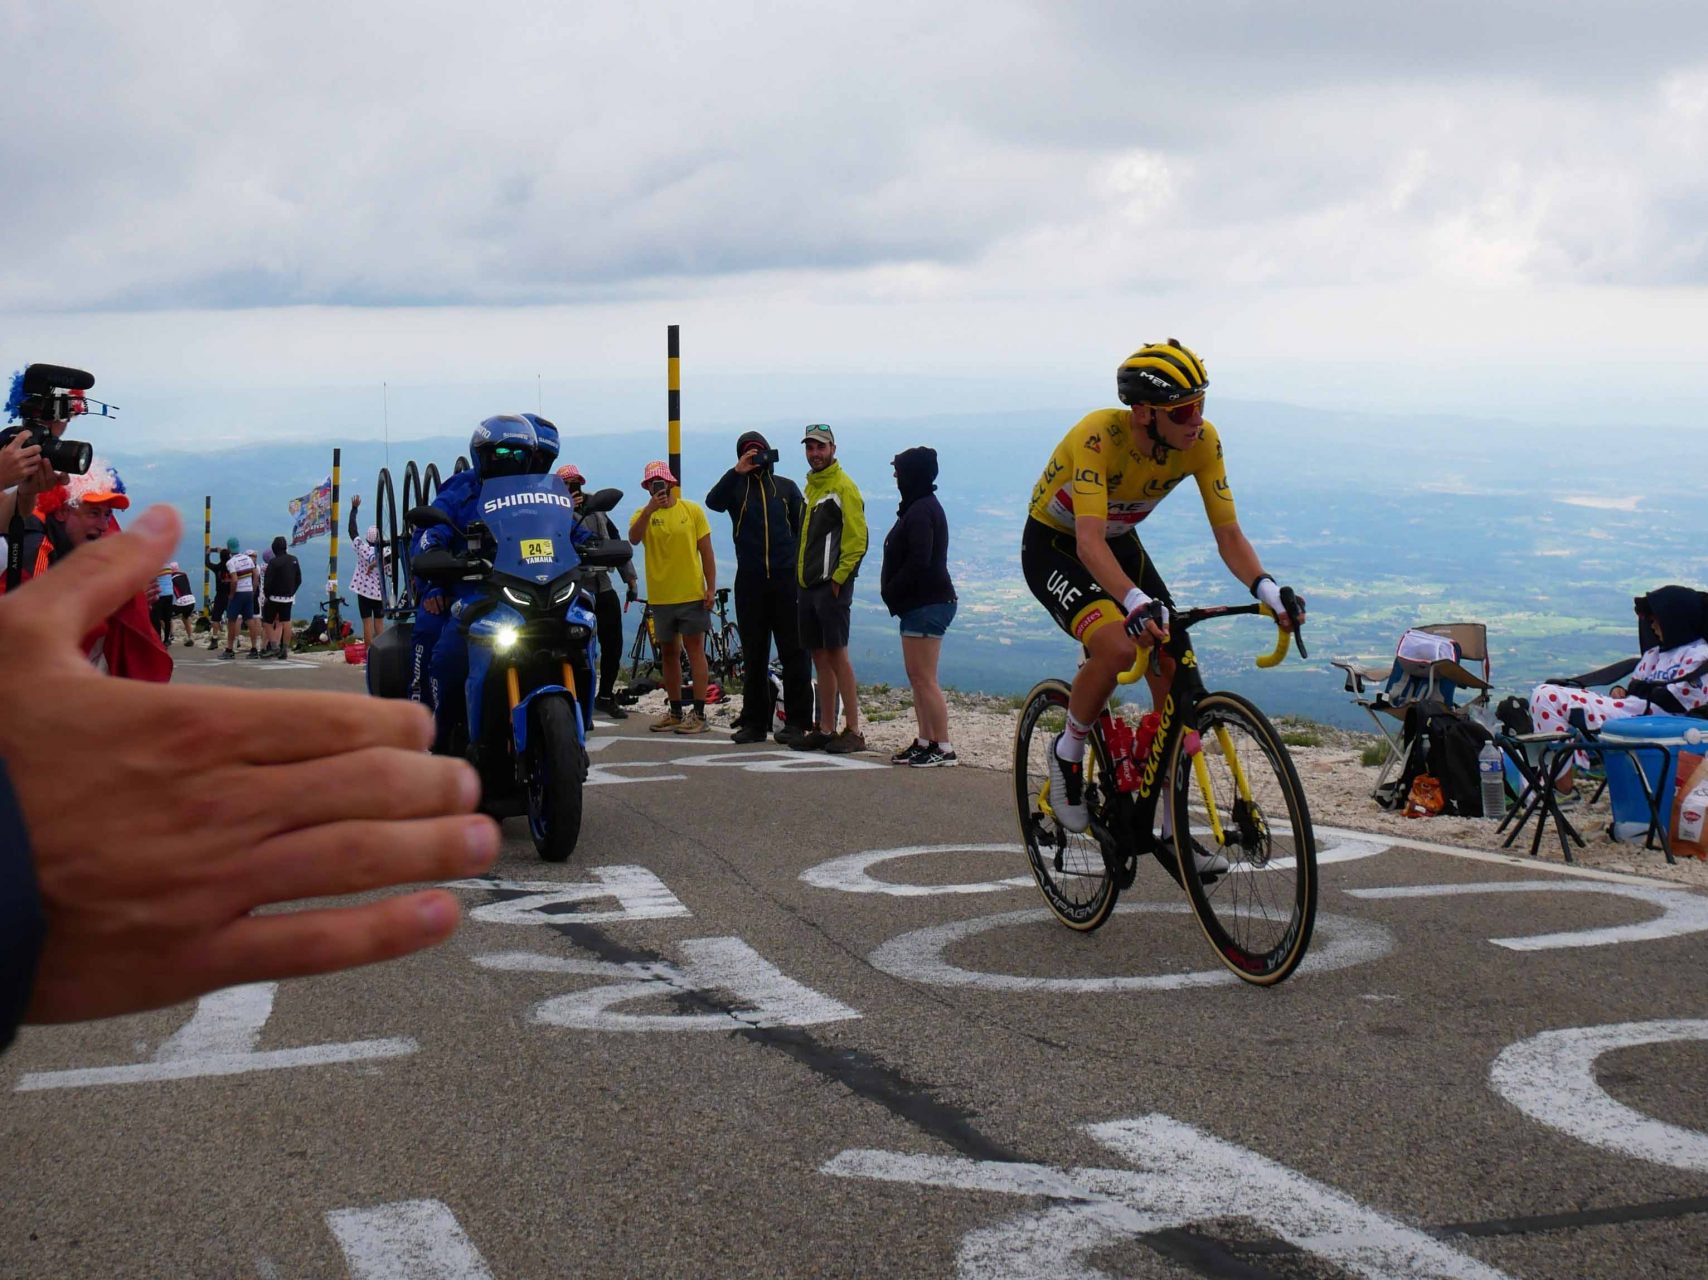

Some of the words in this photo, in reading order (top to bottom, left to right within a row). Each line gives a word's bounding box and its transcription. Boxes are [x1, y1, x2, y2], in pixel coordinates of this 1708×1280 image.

[1139, 371, 1171, 388] MET
[1075, 468, 1104, 487] LCL
[484, 492, 571, 514] SHIMANO
[1107, 502, 1144, 512] AE
[528, 543, 542, 556] 24
[525, 557, 553, 565] YAMAHA
[1046, 570, 1082, 610] UAE
[1139, 693, 1175, 799] COLNAGO
